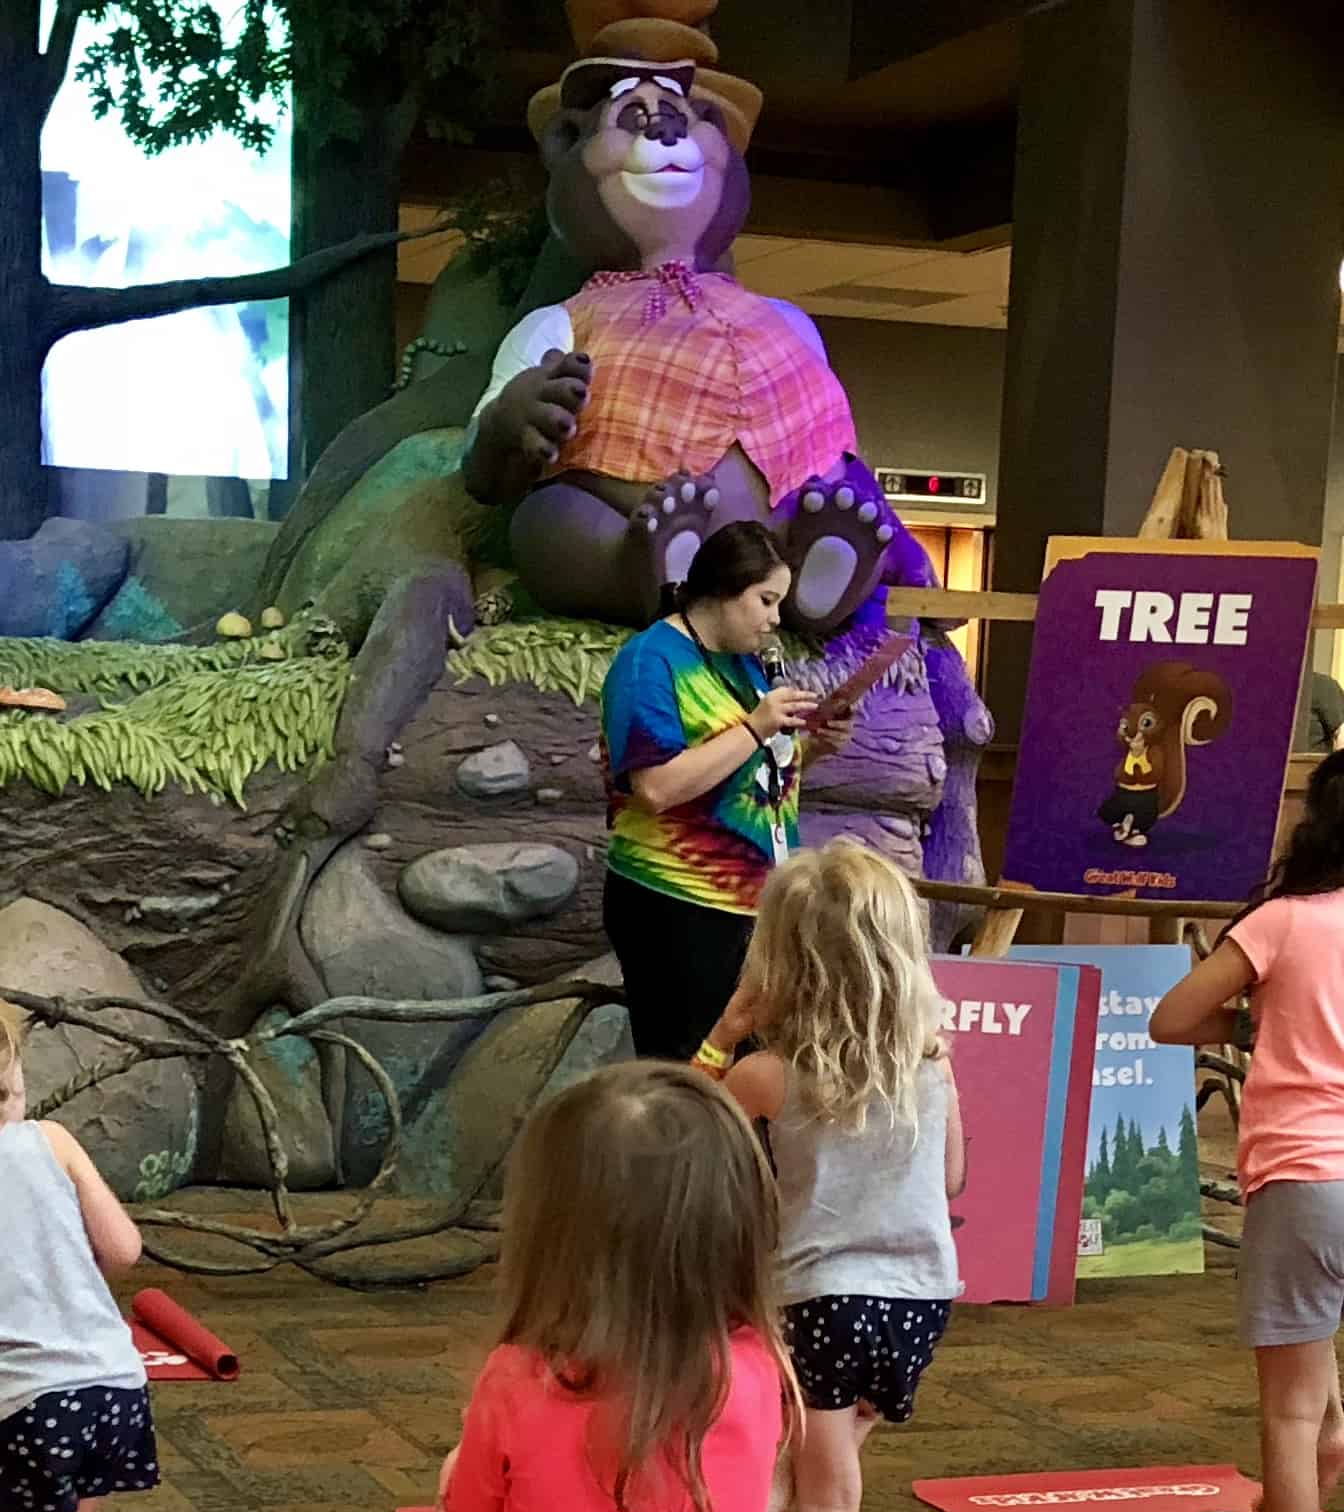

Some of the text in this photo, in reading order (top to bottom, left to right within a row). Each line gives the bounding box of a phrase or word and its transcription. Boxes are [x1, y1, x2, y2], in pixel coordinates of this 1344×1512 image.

[1095, 589, 1253, 646] TREE
[936, 1000, 1032, 1036] RFLY
[1096, 1031, 1157, 1051] rom
